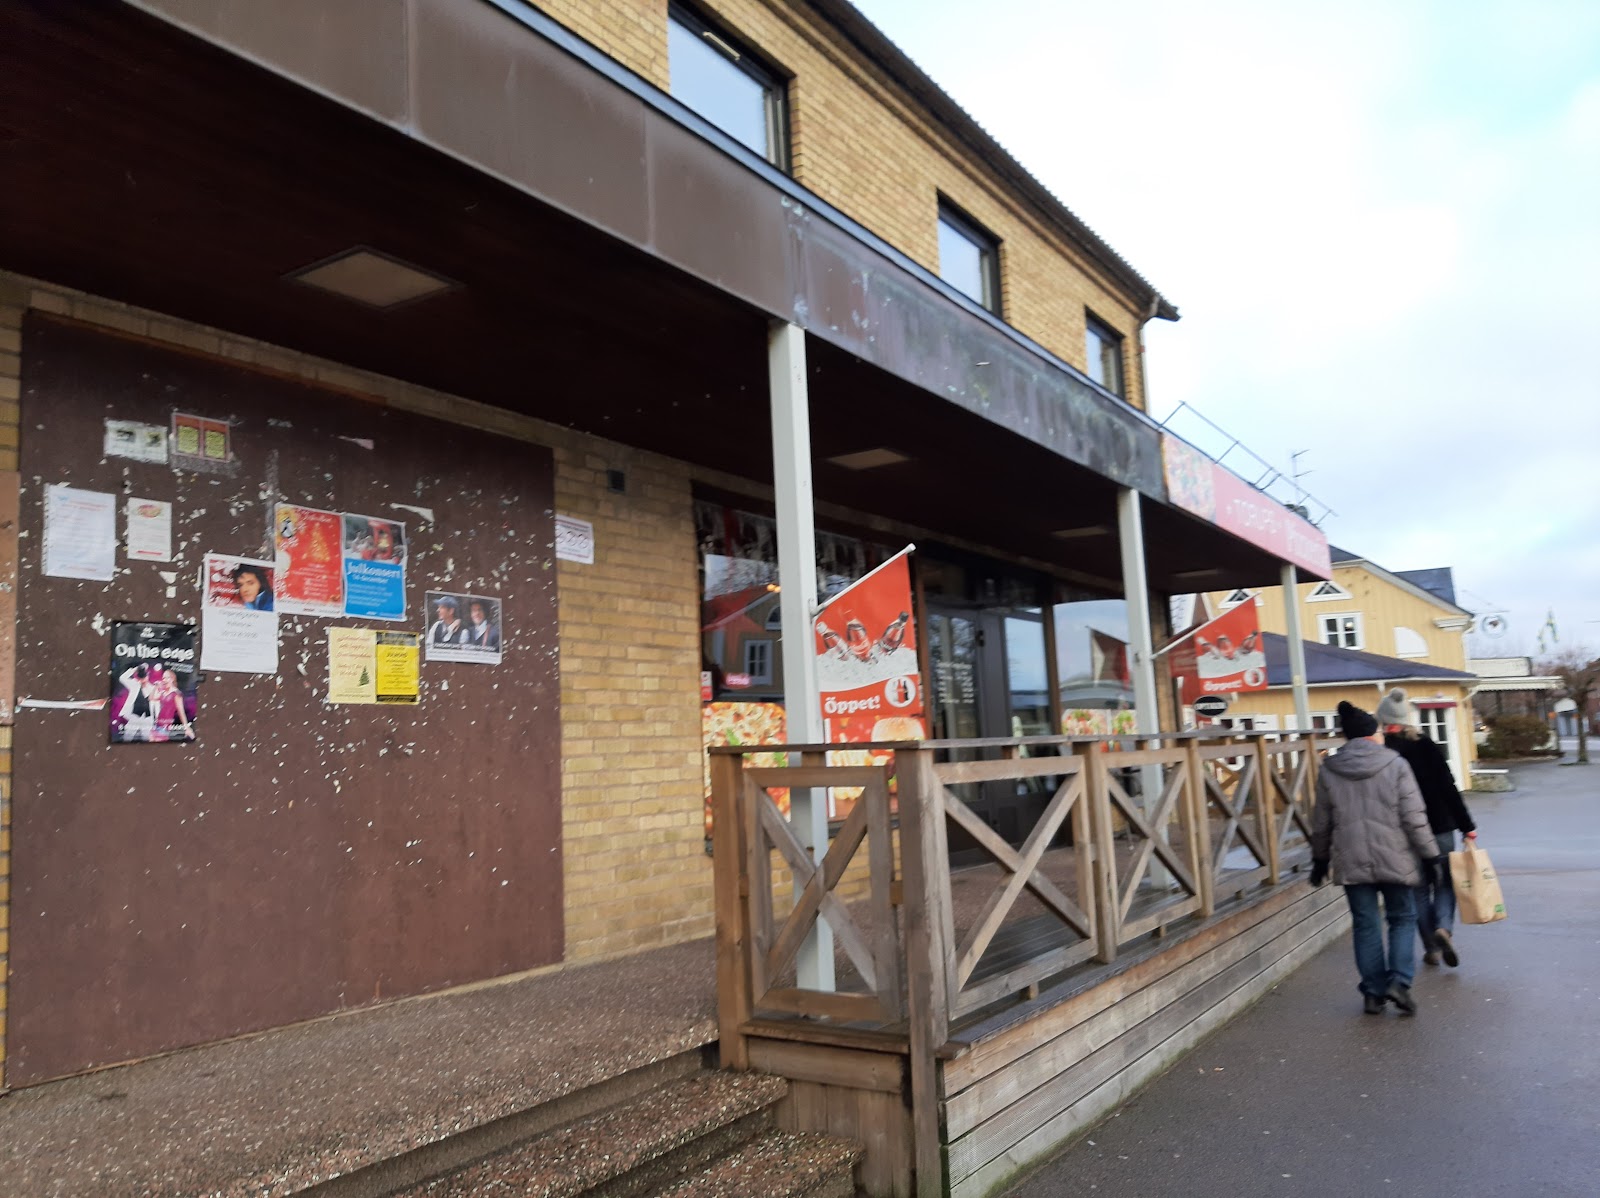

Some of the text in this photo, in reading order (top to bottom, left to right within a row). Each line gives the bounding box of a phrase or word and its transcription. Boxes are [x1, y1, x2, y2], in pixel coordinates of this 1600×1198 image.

[115, 643, 136, 658] On
[137, 643, 160, 659] the
[161, 647, 194, 663] edge
[824, 695, 881, 714] Öppet!
